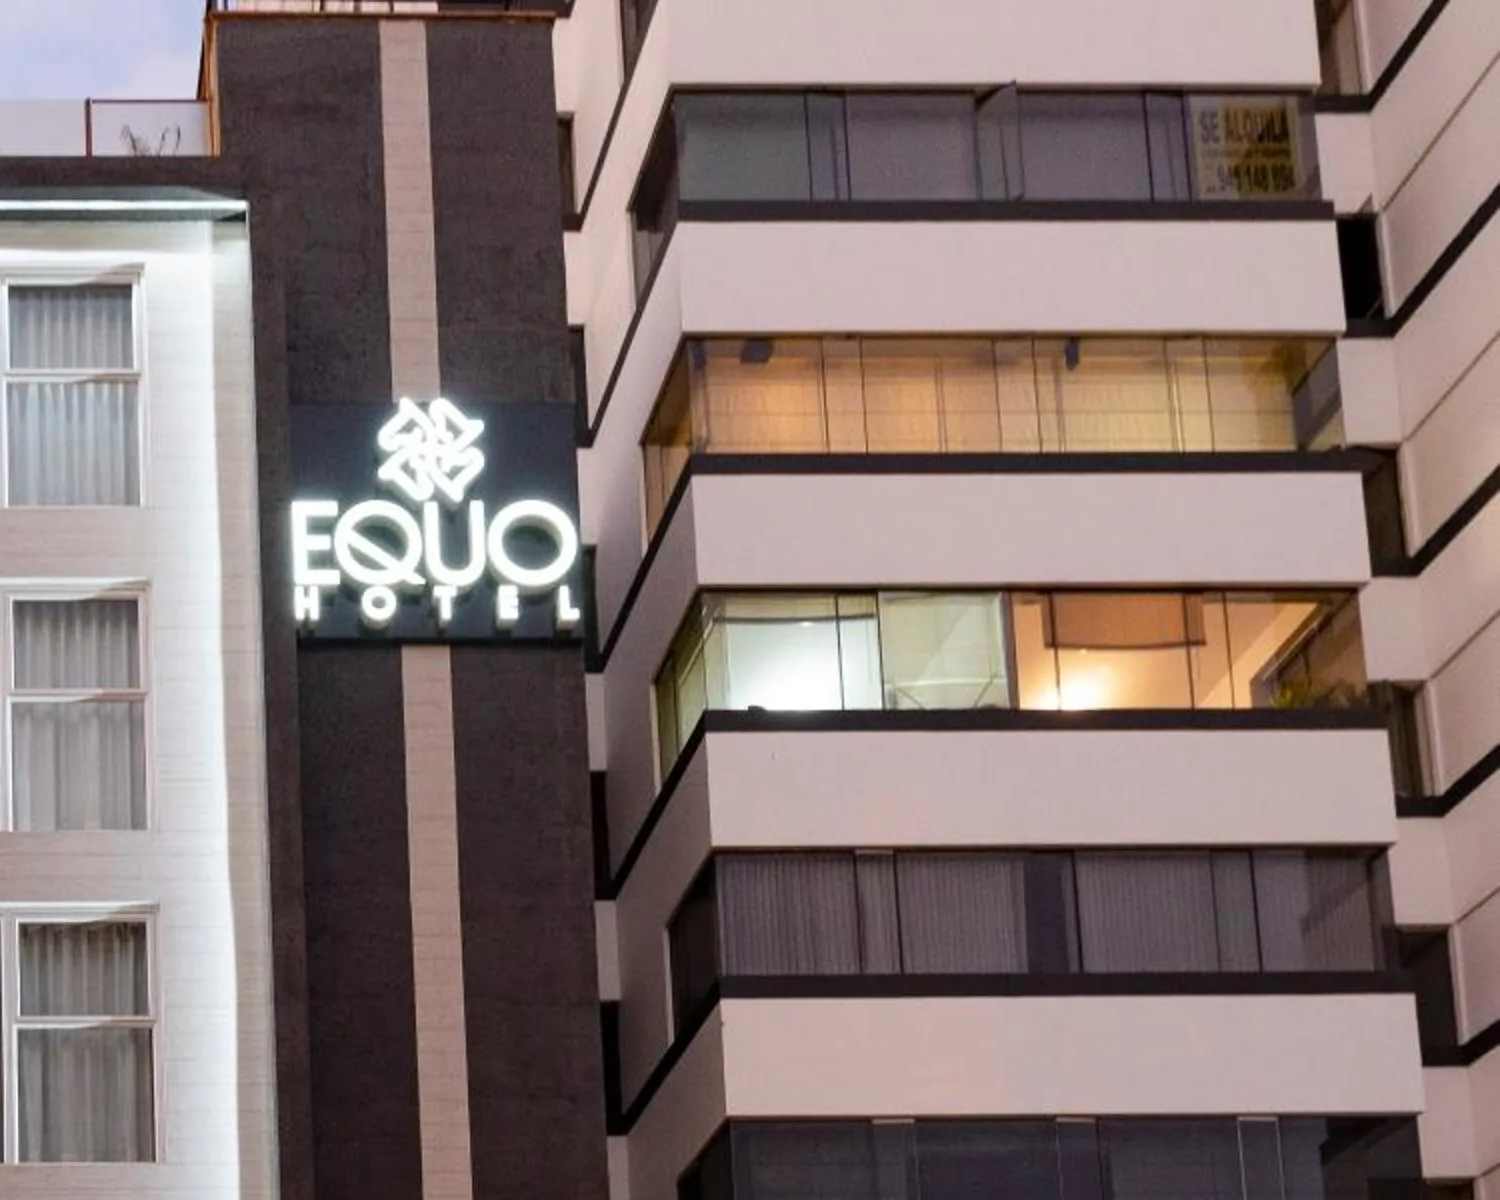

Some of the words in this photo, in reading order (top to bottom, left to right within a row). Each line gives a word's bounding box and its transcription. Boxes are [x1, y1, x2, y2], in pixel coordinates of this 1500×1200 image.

[1199, 110, 1219, 144] SE
[291, 499, 579, 587] EQUO
[293, 585, 581, 624] HOTEL
